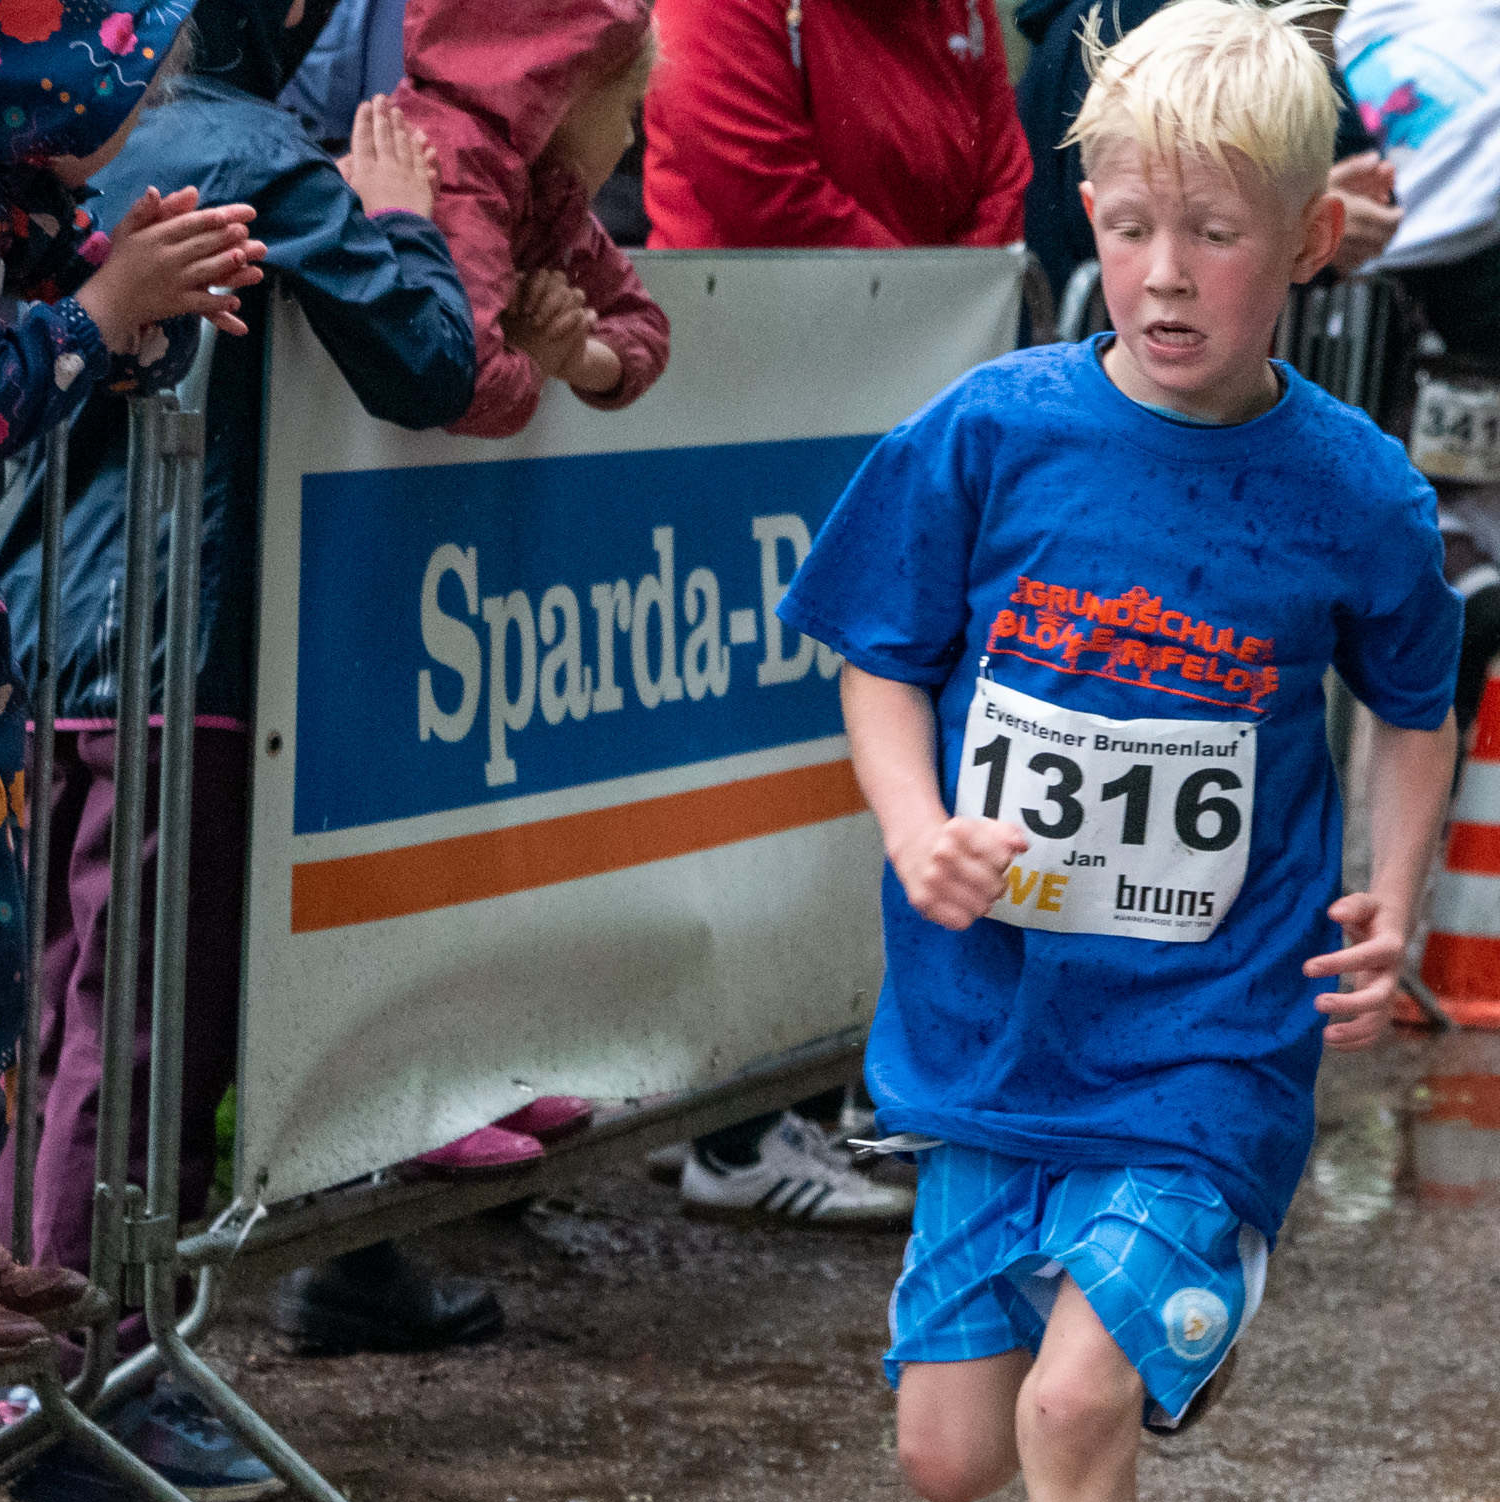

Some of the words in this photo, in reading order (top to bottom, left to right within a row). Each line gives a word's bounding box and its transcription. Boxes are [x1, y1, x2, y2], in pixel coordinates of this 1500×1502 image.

[1024, 578, 1267, 663] GRUNDSCHULE
[985, 701, 1087, 747] Everstener
[1094, 735, 1238, 757] Brunnenlauf
[973, 735, 1243, 851] 1316
[1062, 850, 1107, 868] Jan
[1115, 874, 1215, 918] bruns
